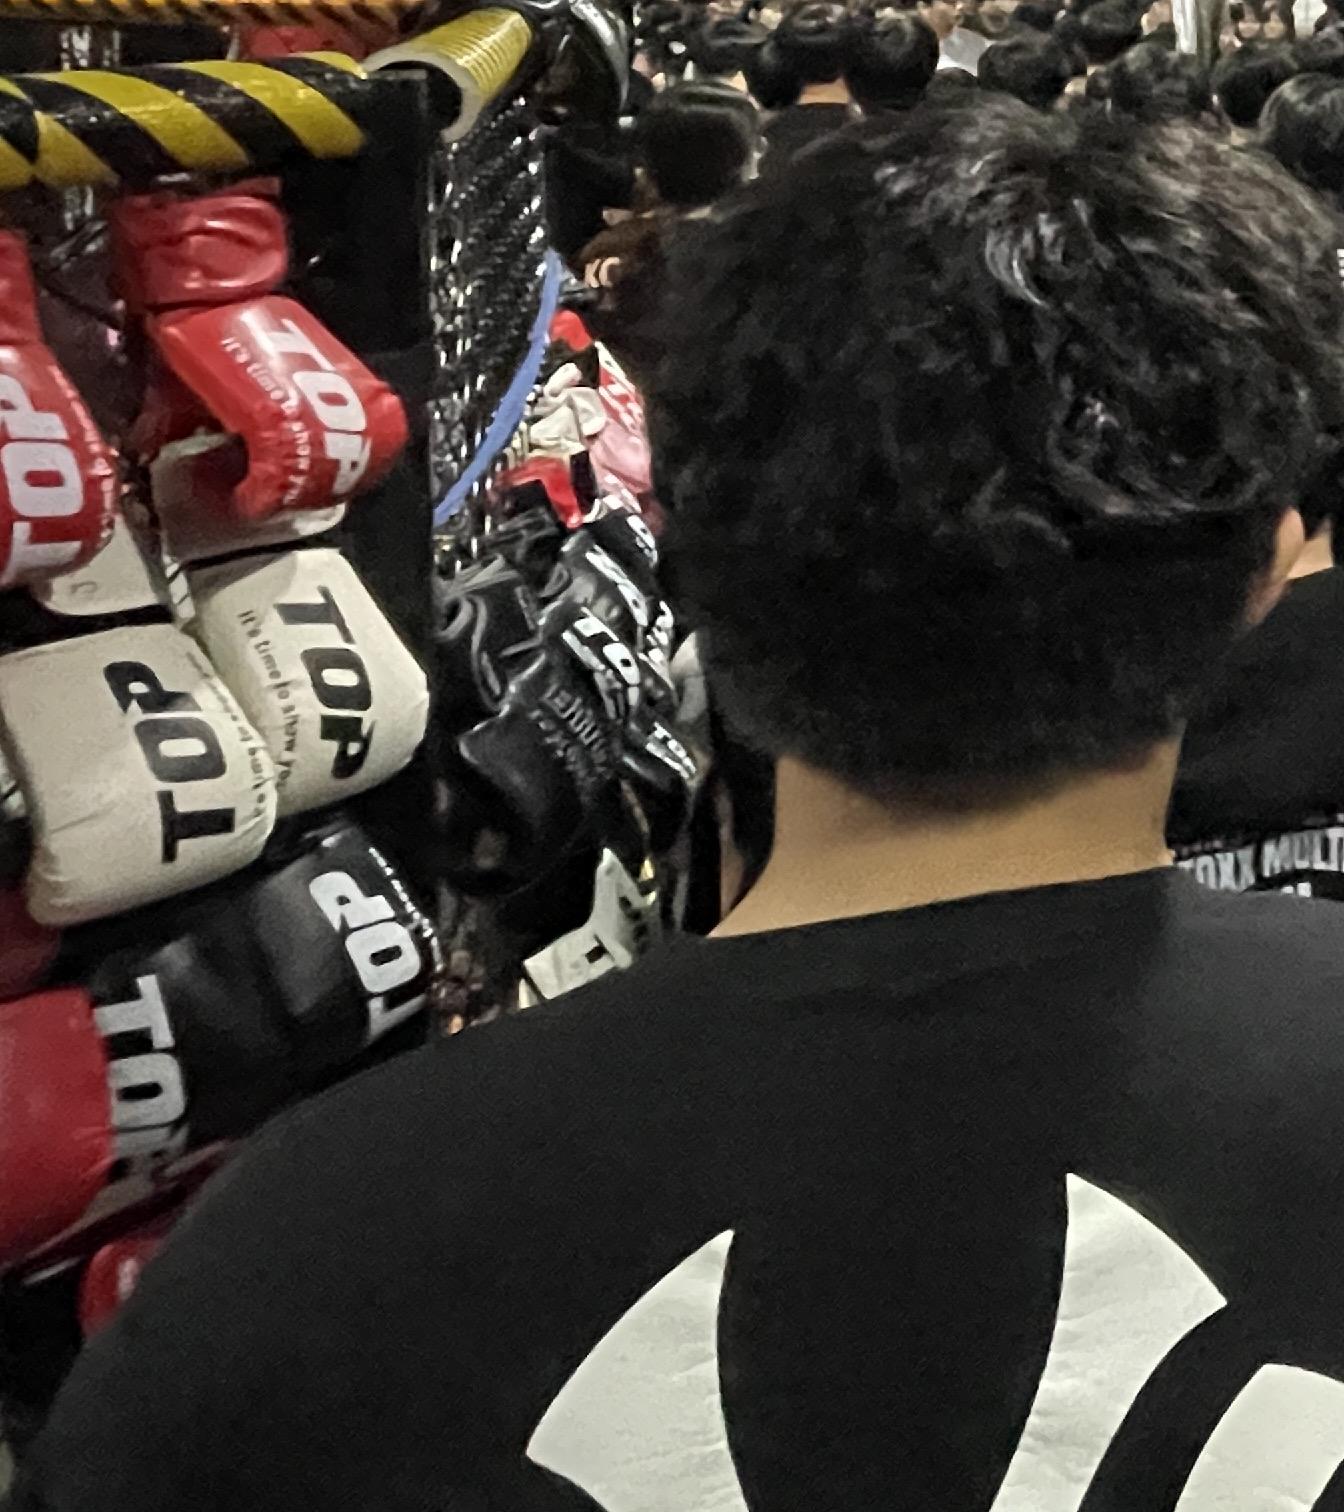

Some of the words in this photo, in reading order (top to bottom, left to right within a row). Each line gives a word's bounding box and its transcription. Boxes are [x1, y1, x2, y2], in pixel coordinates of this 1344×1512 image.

[259, 317, 372, 496] TOP
[102, 659, 236, 865] TOP
[272, 584, 377, 780] TOP
[308, 870, 427, 1044] TOP
[1176, 844, 1255, 891] OXX
